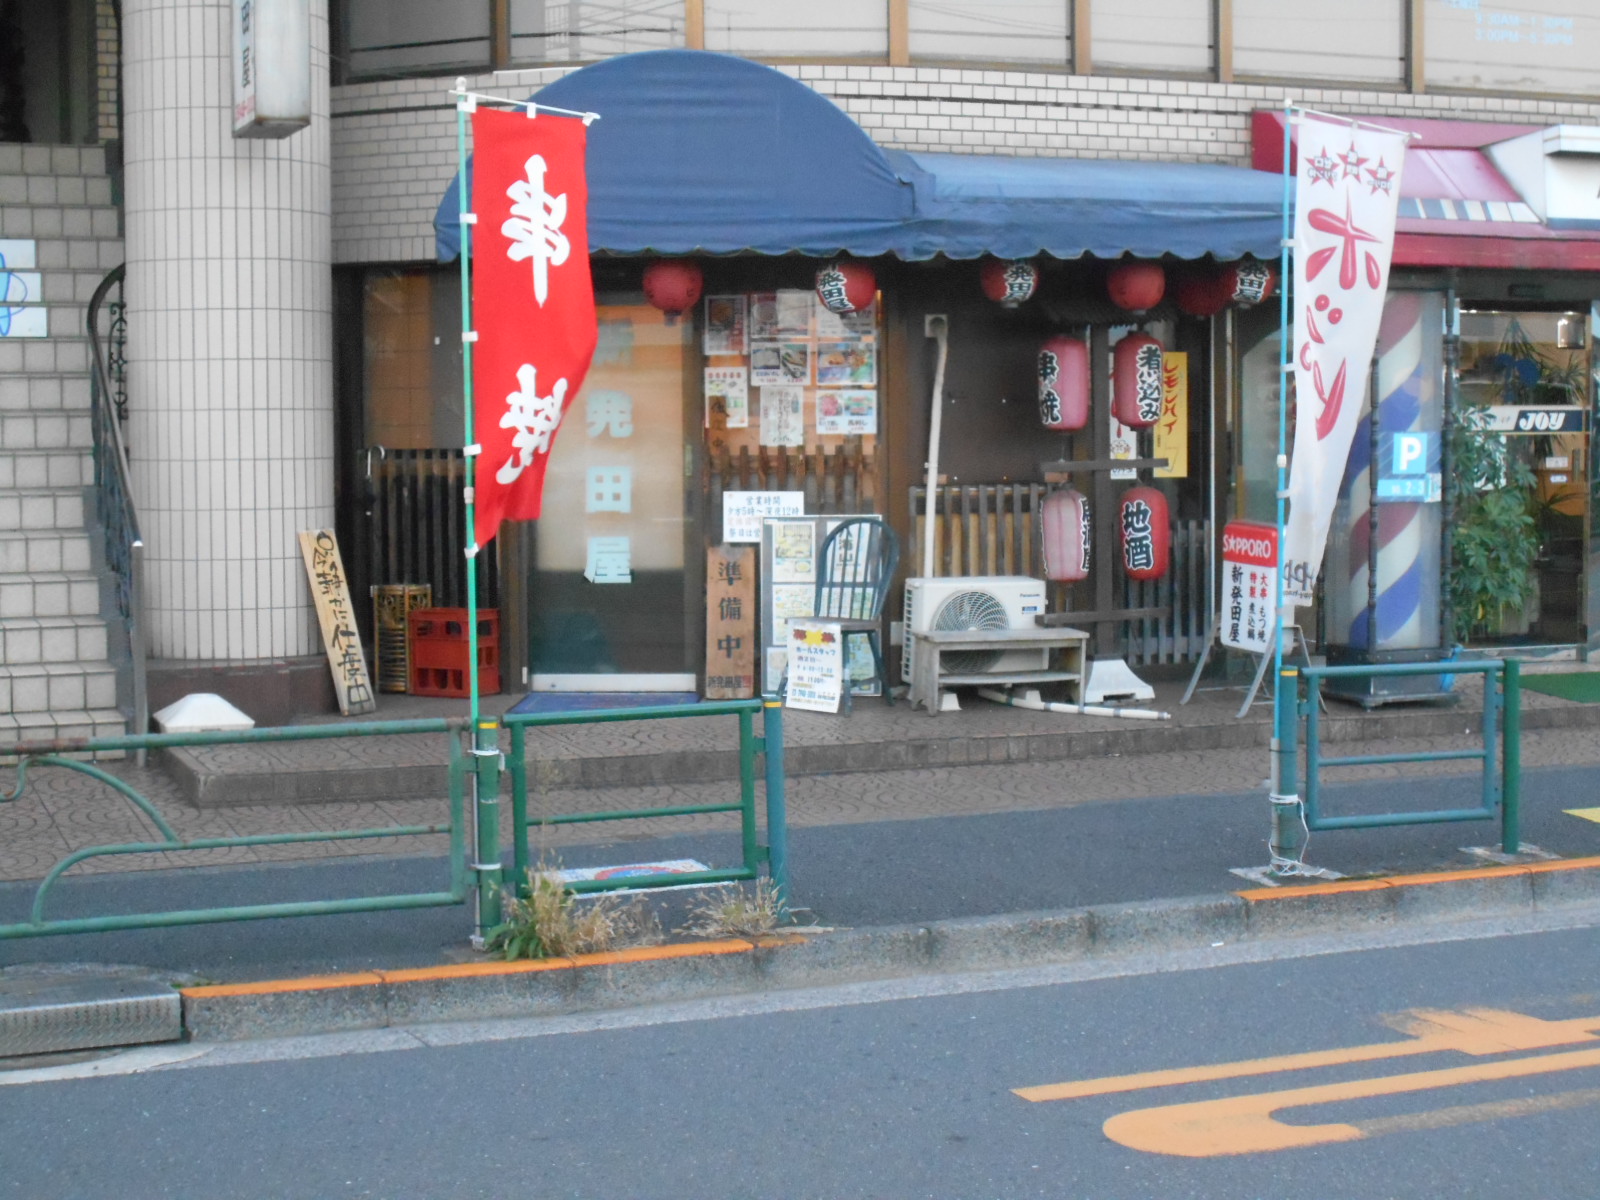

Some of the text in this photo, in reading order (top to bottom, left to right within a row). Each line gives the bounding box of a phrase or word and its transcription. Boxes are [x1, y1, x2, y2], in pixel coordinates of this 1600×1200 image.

[1137, 343, 1161, 422] 煮込み
[1399, 437, 1422, 470] P
[1519, 412, 1565, 431] JOY
[1122, 500, 1154, 570] 地酒
[718, 560, 742, 659] 準備中
[1229, 563, 1243, 643] 新発田屋
